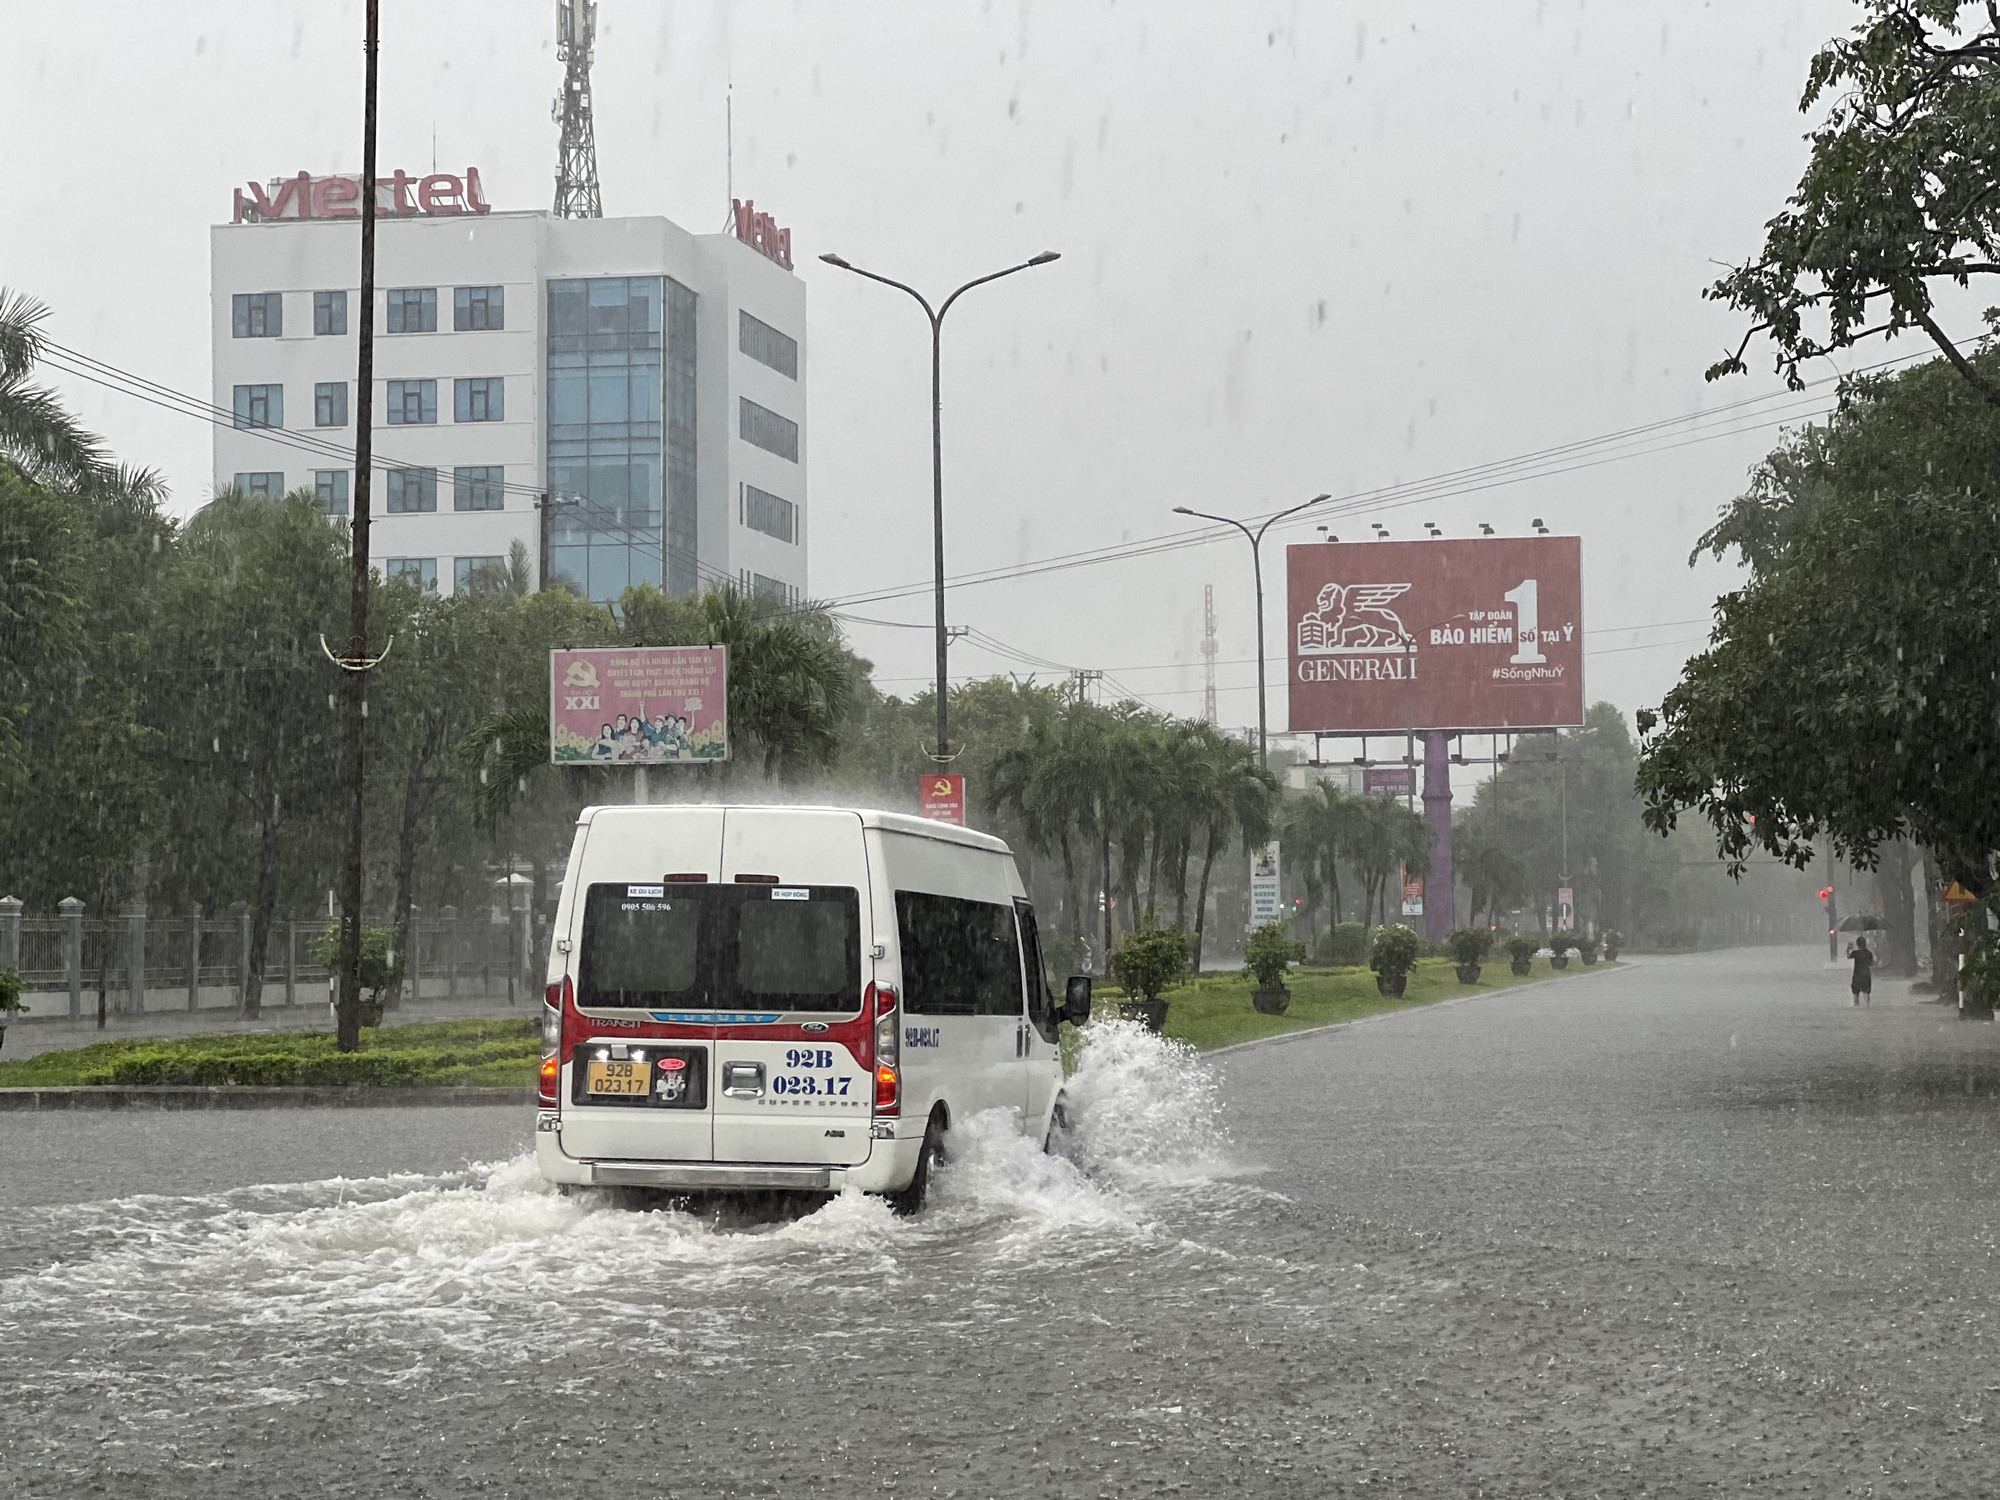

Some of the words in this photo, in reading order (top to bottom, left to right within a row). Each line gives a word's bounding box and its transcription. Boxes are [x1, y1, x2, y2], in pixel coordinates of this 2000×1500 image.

[1469, 610, 1486, 622] TẬP
[1487, 609, 1513, 620] ĐOÀN
[1504, 579, 1546, 664] 1
[1430, 623, 1465, 645] BẢO
[1469, 621, 1513, 644] HIỂM
[1541, 630, 1560, 645] TẠI
[1562, 622, 1574, 642] Ý
[1297, 657, 1418, 682] GENERALI
[1492, 664, 1565, 681] #SốngNhưÝ
[564, 696, 600, 710] XXI
[621, 903, 640, 911] 0905
[657, 903, 672, 911] 596
[590, 1018, 642, 1028] TRANSIT
[668, 1013, 763, 1022] LUXURY
[786, 1049, 834, 1068] 92B
[606, 1063, 633, 1078] 92B
[595, 1078, 644, 1093] 023.17
[773, 1075, 853, 1096] 023.17
[758, 1099, 812, 1107] SUPER
[818, 1100, 870, 1108] SPORT
